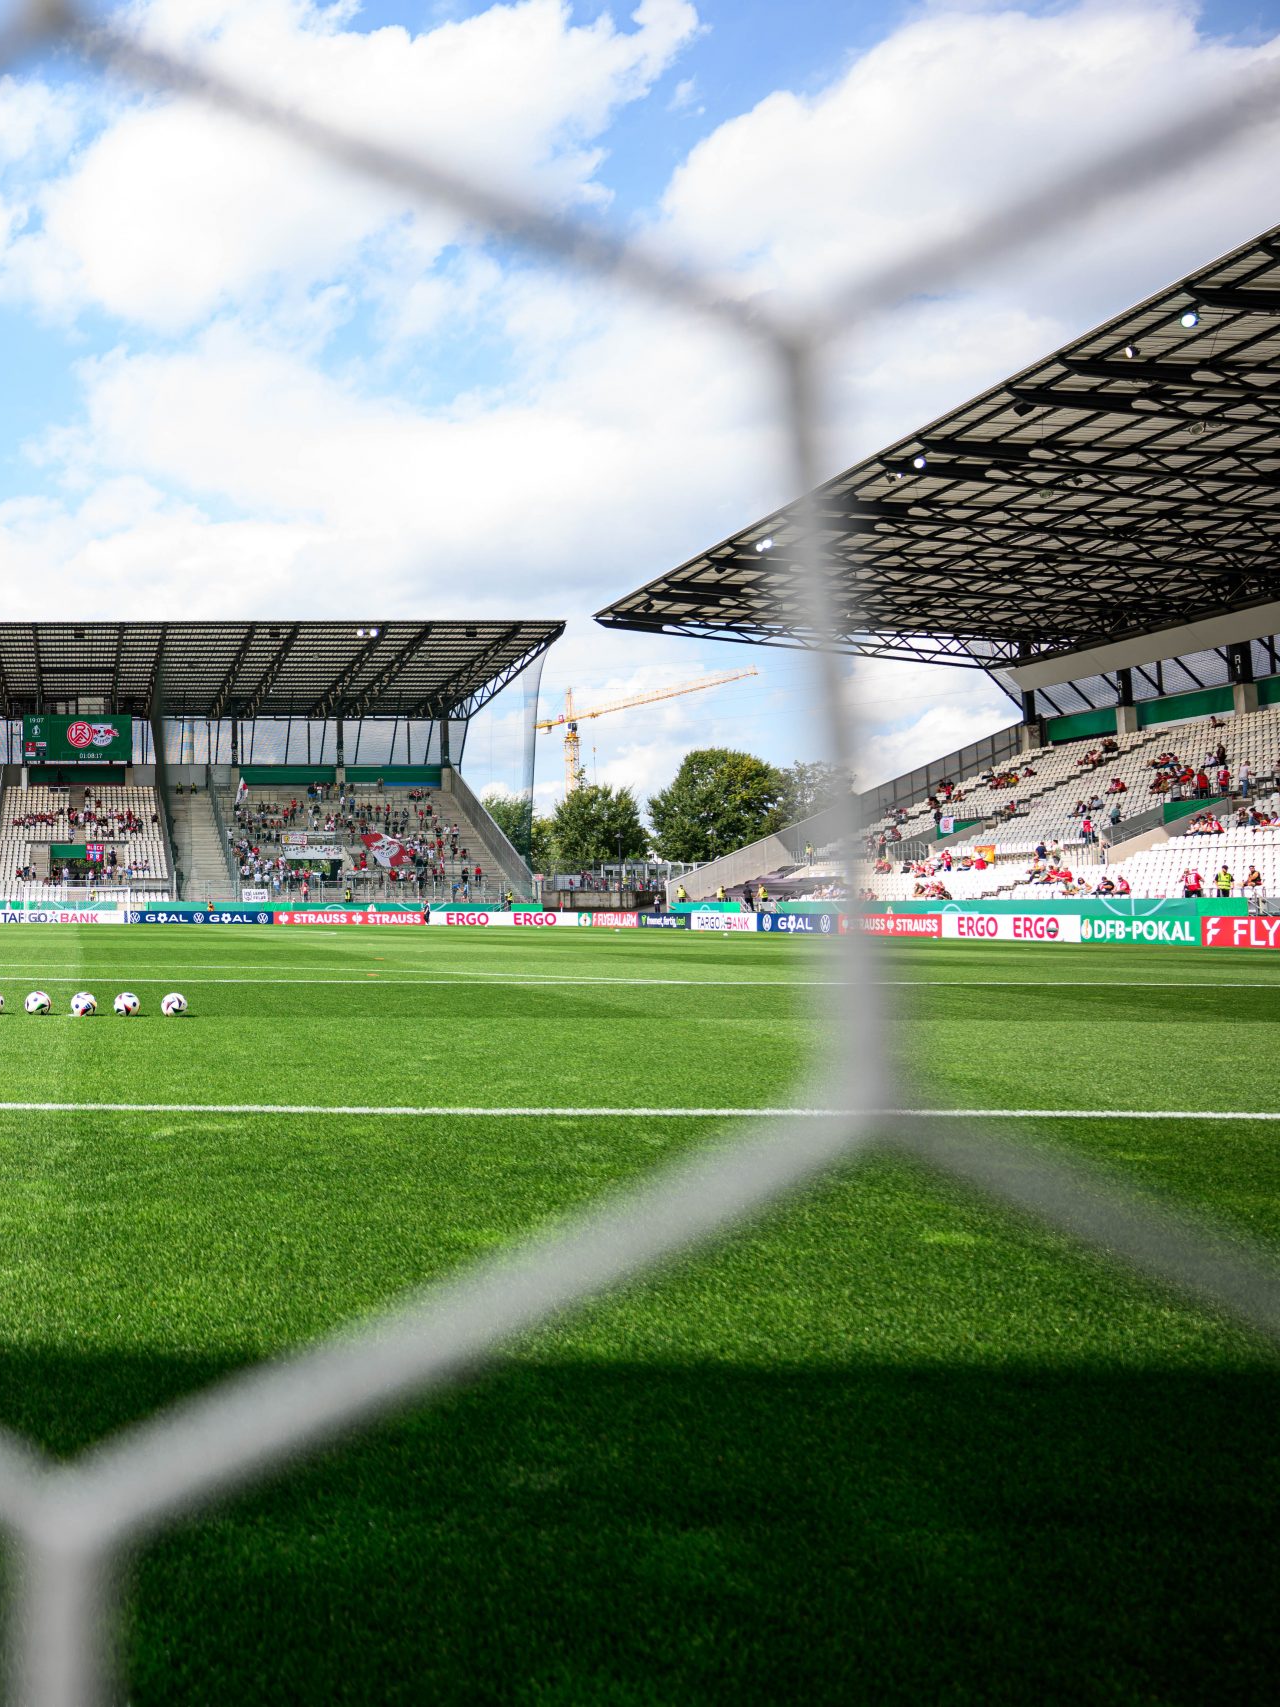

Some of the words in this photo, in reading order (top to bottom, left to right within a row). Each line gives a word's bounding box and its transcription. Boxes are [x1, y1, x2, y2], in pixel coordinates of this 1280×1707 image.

[293, 913, 347, 924] STRAUSS
[367, 913, 421, 924] STRAUSS
[446, 913, 489, 926] ERGO
[513, 913, 557, 926] ERGO
[597, 913, 637, 926] FLYERALARM
[896, 918, 938, 932] STRAUSS
[957, 916, 998, 937] ERGO
[1013, 917, 1059, 938] ERGO
[1094, 920, 1195, 941] DFB-POKAL
